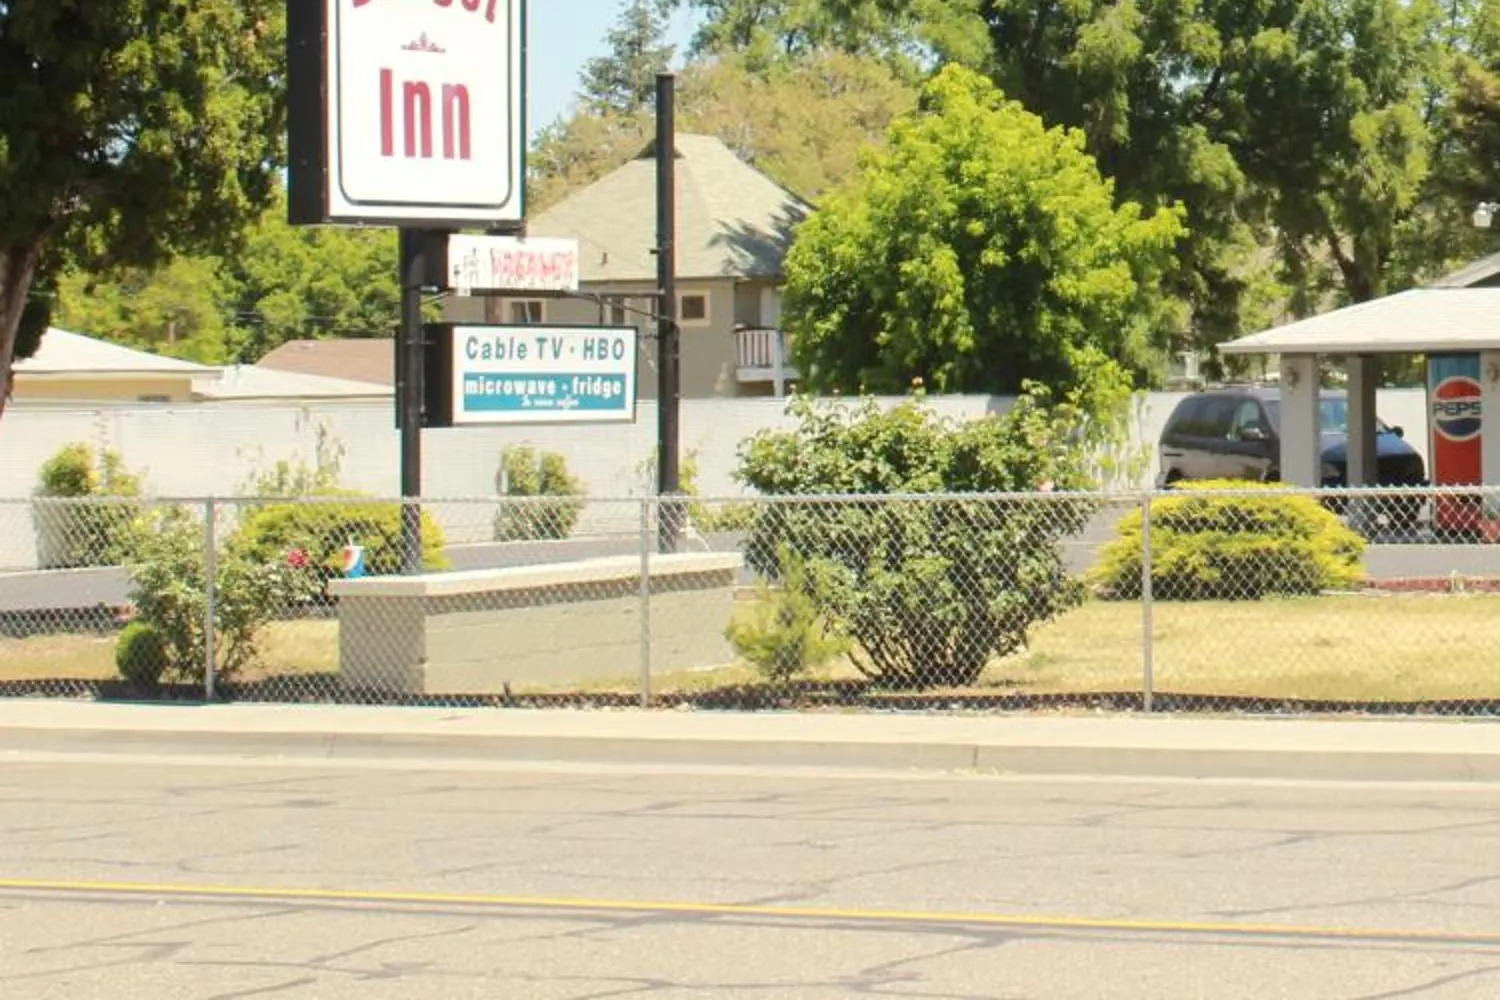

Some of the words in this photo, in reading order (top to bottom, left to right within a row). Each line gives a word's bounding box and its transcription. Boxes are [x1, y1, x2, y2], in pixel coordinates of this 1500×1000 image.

[379, 68, 471, 160] Inn
[465, 335, 528, 360] Cable
[536, 336, 563, 360] TV
[583, 337, 625, 361] HBO
[464, 376, 556, 395] microwave
[572, 376, 622, 399] fridge
[1433, 402, 1481, 416] PEPS
